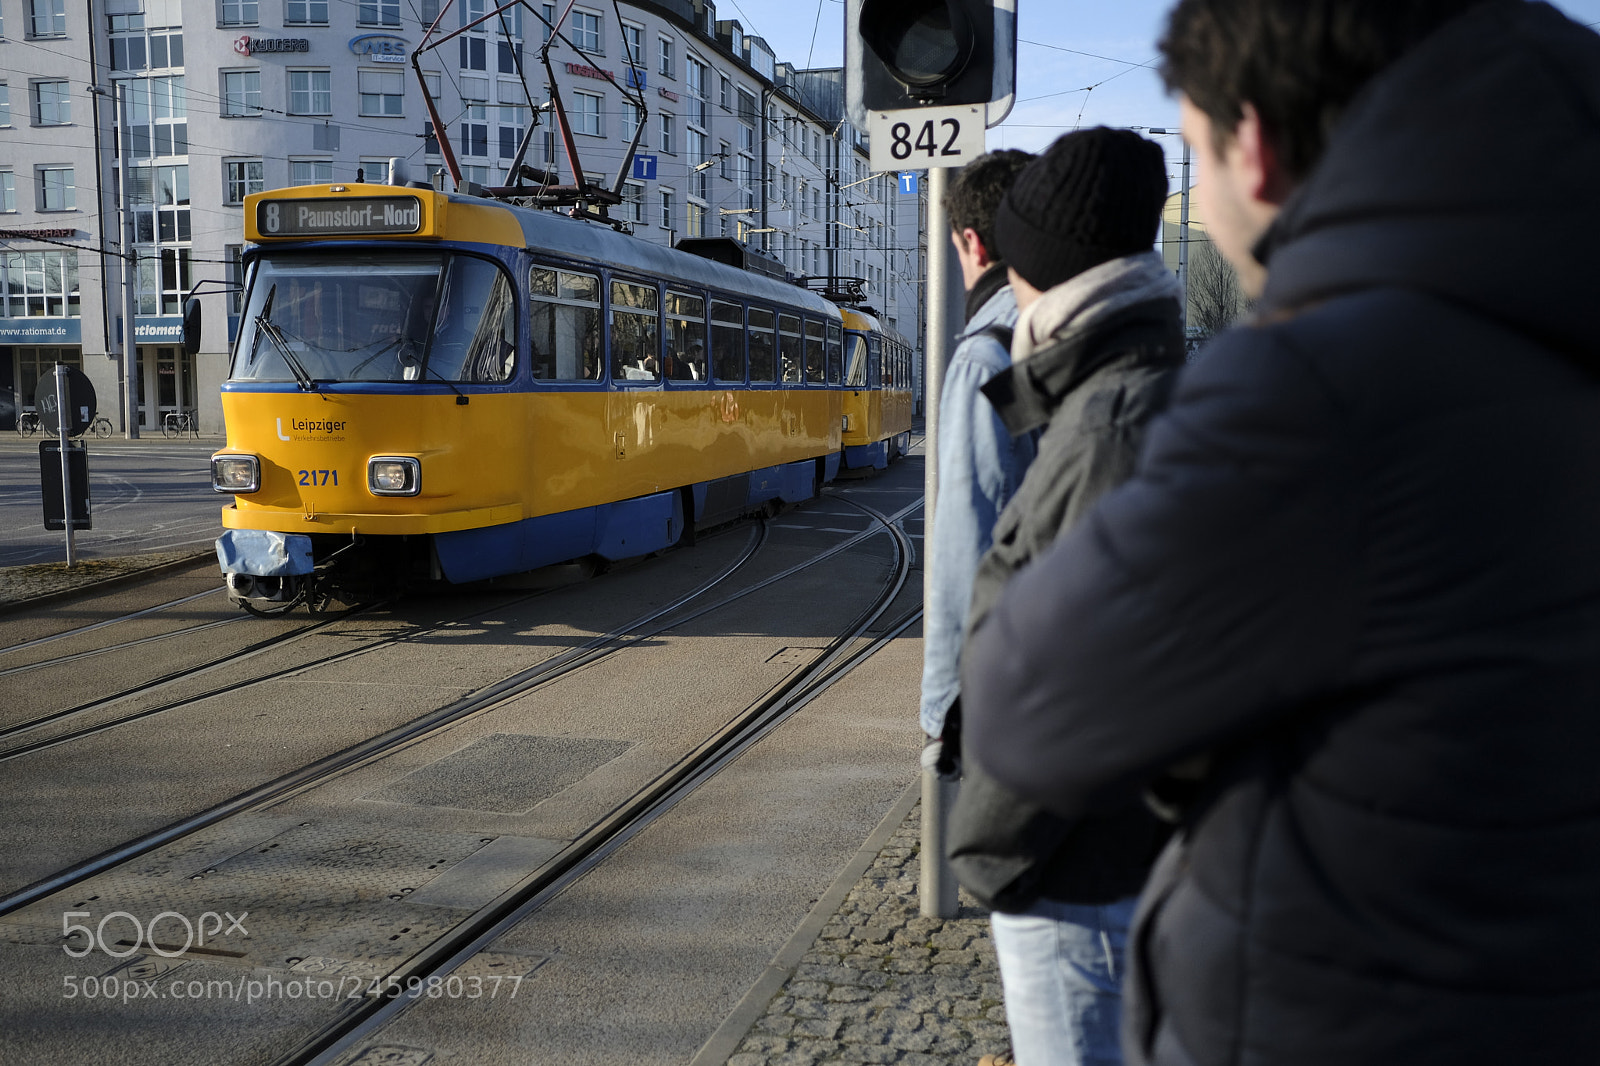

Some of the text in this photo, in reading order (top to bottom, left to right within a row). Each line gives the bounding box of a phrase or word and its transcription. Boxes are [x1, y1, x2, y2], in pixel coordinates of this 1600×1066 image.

[251, 39, 308, 52] KYOCERA
[361, 40, 406, 55] WBS
[890, 118, 961, 160] 842
[639, 157, 652, 176] T
[902, 175, 912, 191] T
[266, 203, 418, 233] 8 Paunsdorf-Nord
[0, 327, 66, 336] www.ratiomat.de
[292, 418, 346, 433] Leipziger
[298, 469, 338, 486] 2171
